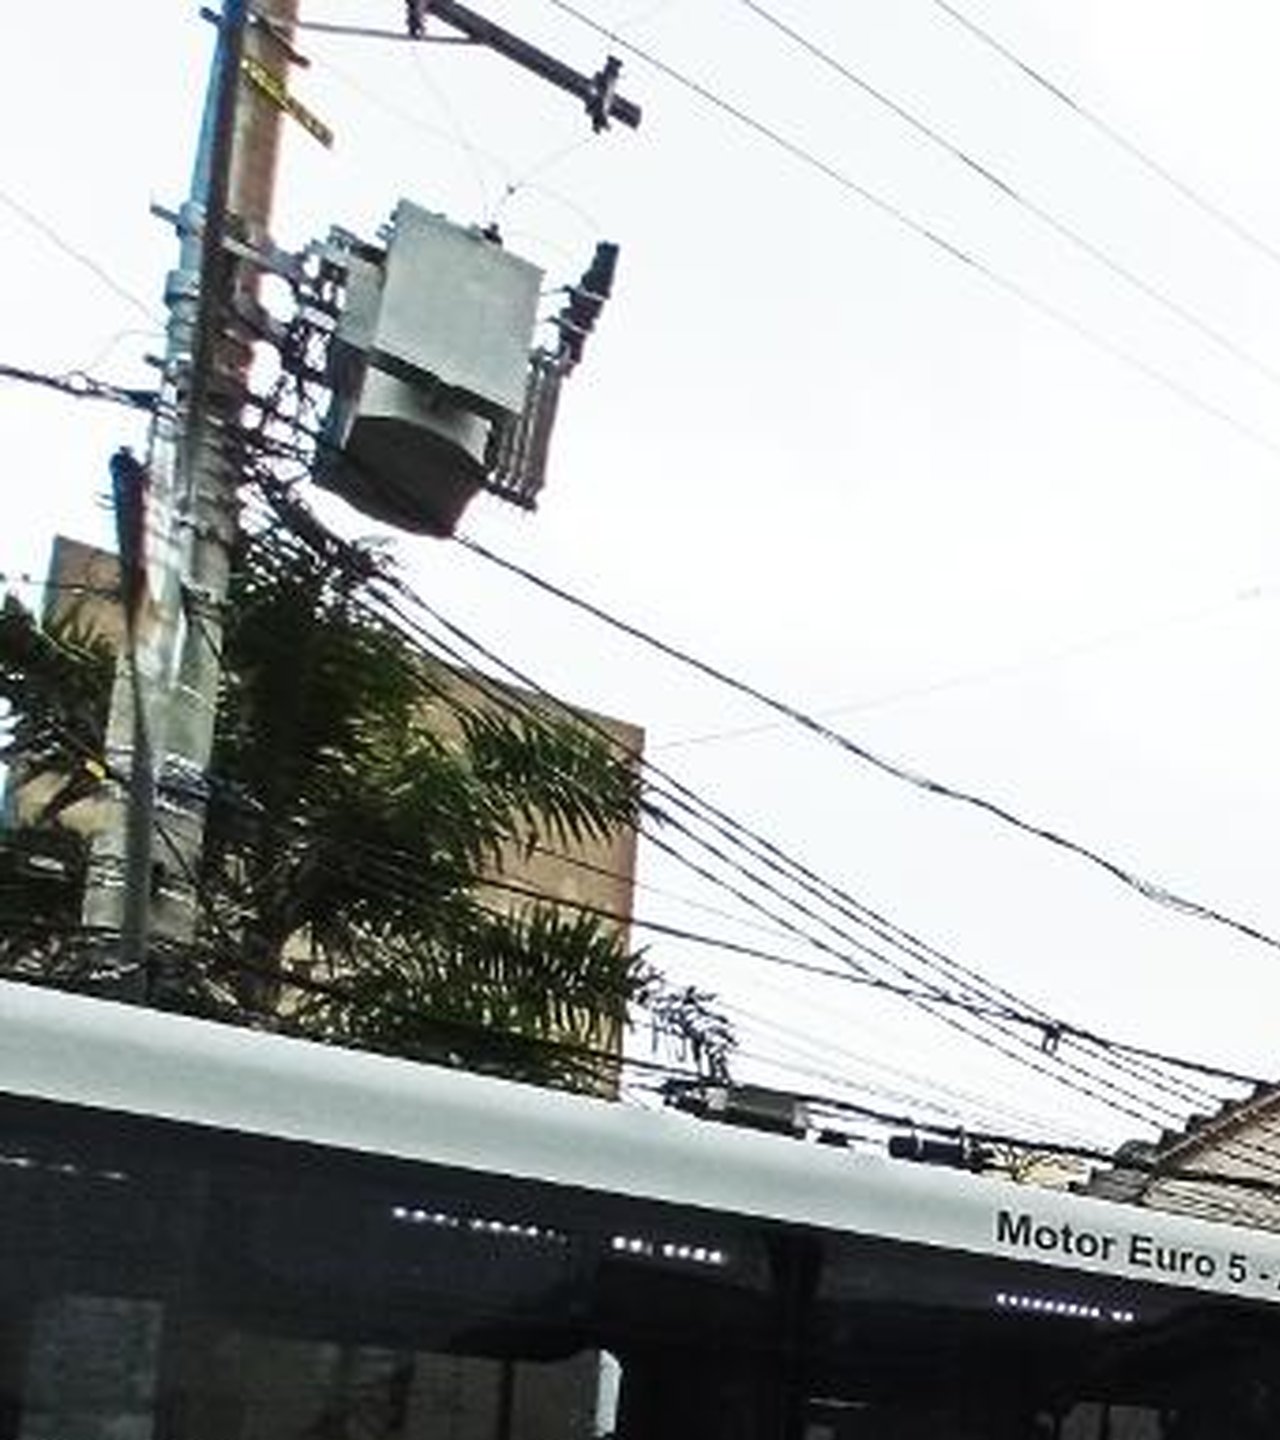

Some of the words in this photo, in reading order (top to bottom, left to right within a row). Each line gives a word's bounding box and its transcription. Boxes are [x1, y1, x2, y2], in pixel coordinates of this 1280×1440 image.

[997, 1210, 1118, 1261] Motor
[1128, 1234, 1216, 1278] Euro
[1228, 1252, 1247, 1284] 5
